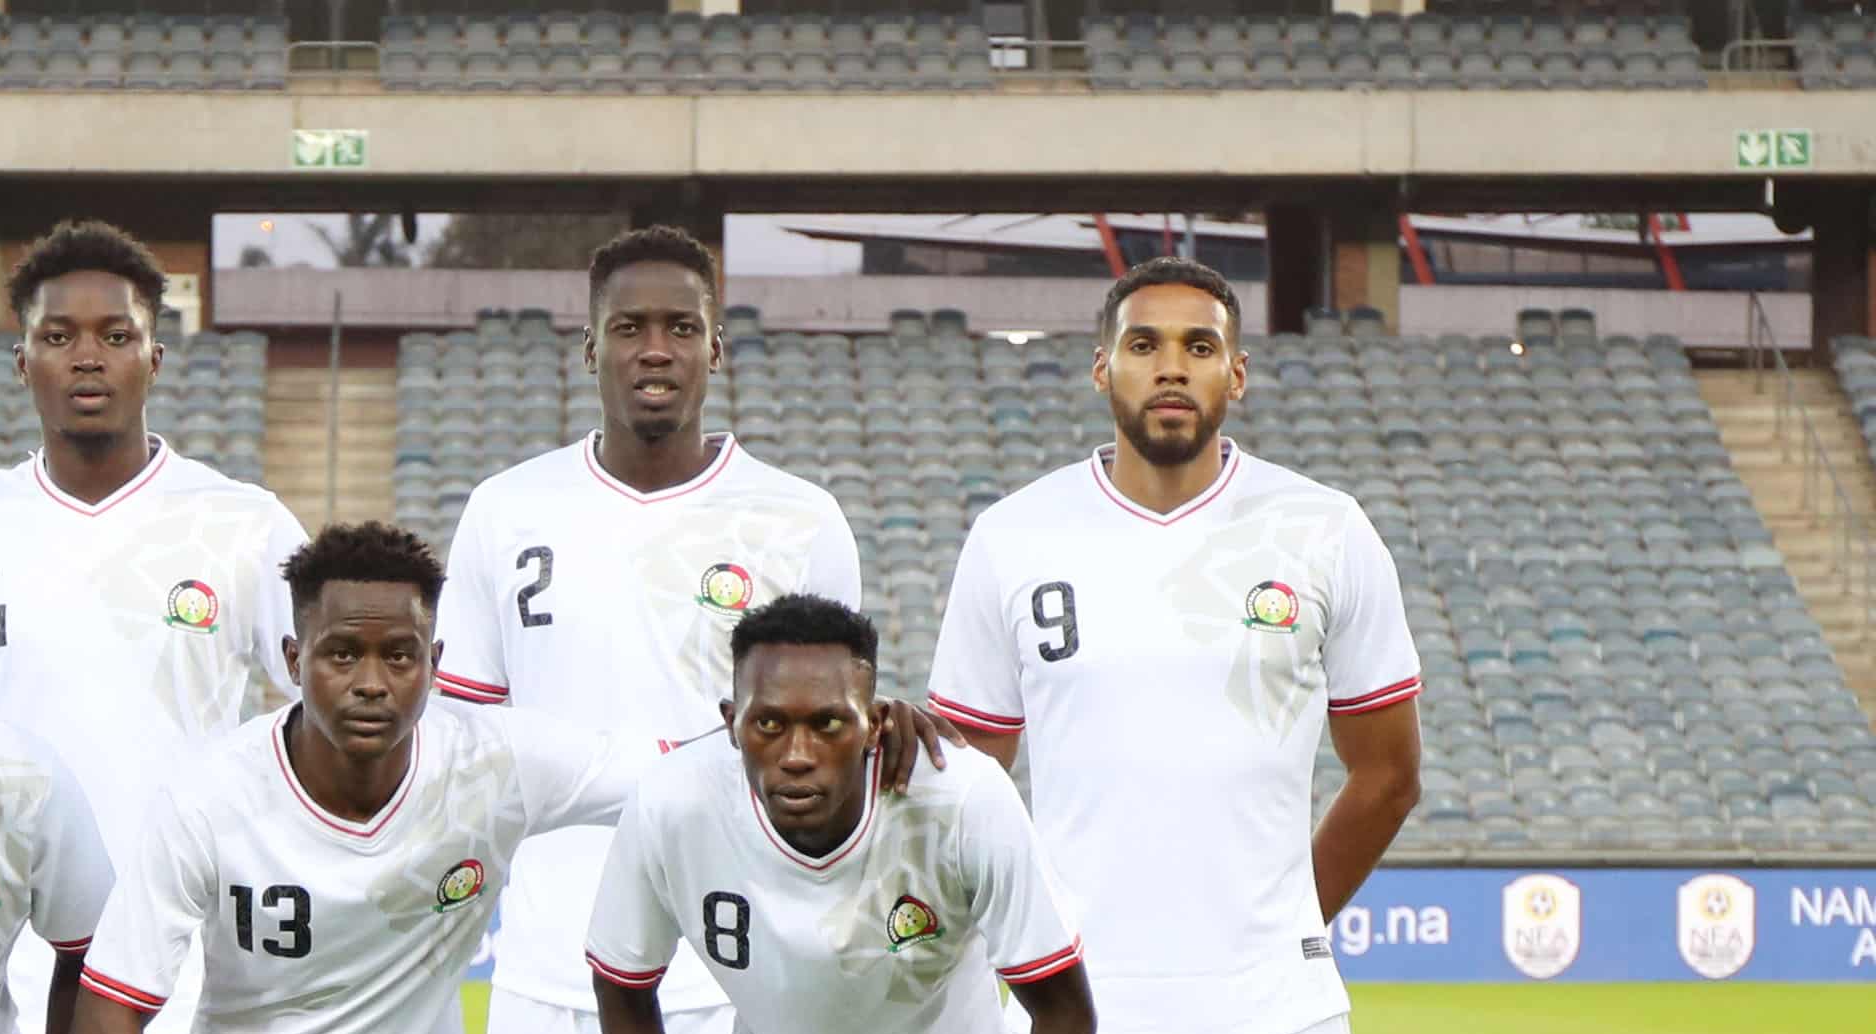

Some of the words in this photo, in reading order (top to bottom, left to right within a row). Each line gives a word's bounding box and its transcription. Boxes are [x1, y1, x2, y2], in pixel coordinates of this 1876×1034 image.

[515, 545, 554, 628] 2
[1031, 580, 1080, 662] 9
[229, 884, 312, 959] 13
[703, 890, 751, 970] 8
